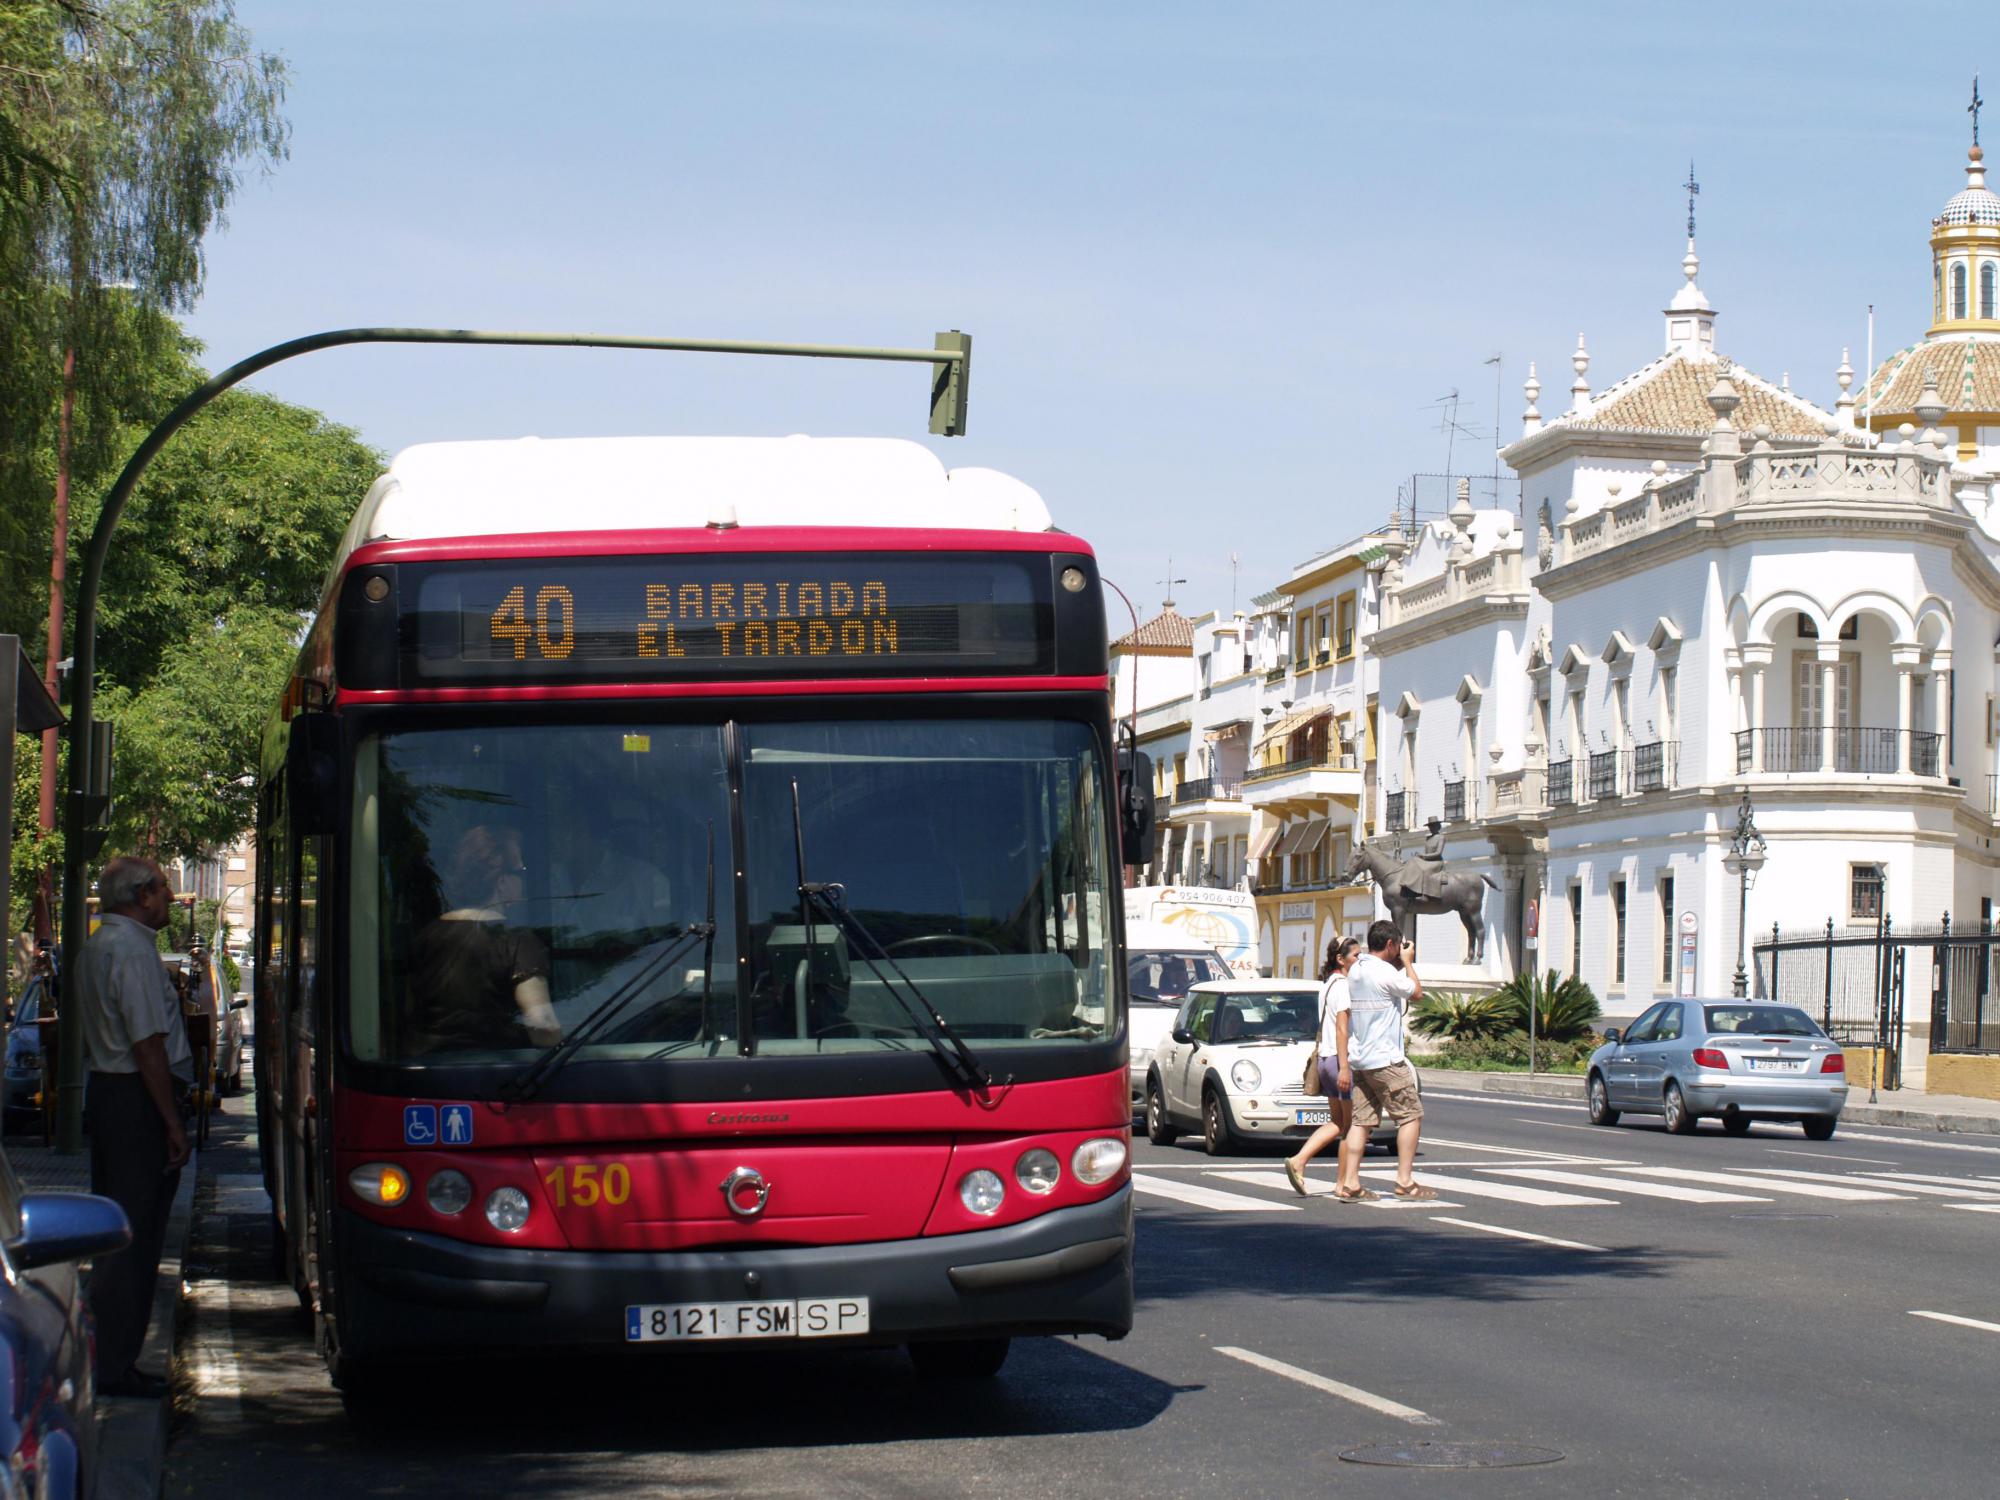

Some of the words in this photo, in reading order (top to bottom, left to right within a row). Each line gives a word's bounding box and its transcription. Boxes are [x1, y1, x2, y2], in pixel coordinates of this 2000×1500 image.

[646, 581, 887, 618] BARRIADA
[491, 585, 575, 660] 40
[638, 622, 685, 657] EL
[715, 619, 897, 656] TARDON
[1179, 891, 1199, 900] 954
[1202, 893, 1223, 902] 906
[1226, 895, 1246, 904] 407
[706, 1111, 790, 1125] Castrosua
[1305, 1111, 1332, 1123] 2098
[545, 1162, 631, 1207] 150
[651, 1308, 718, 1336] 8121
[737, 1306, 790, 1333] FSM
